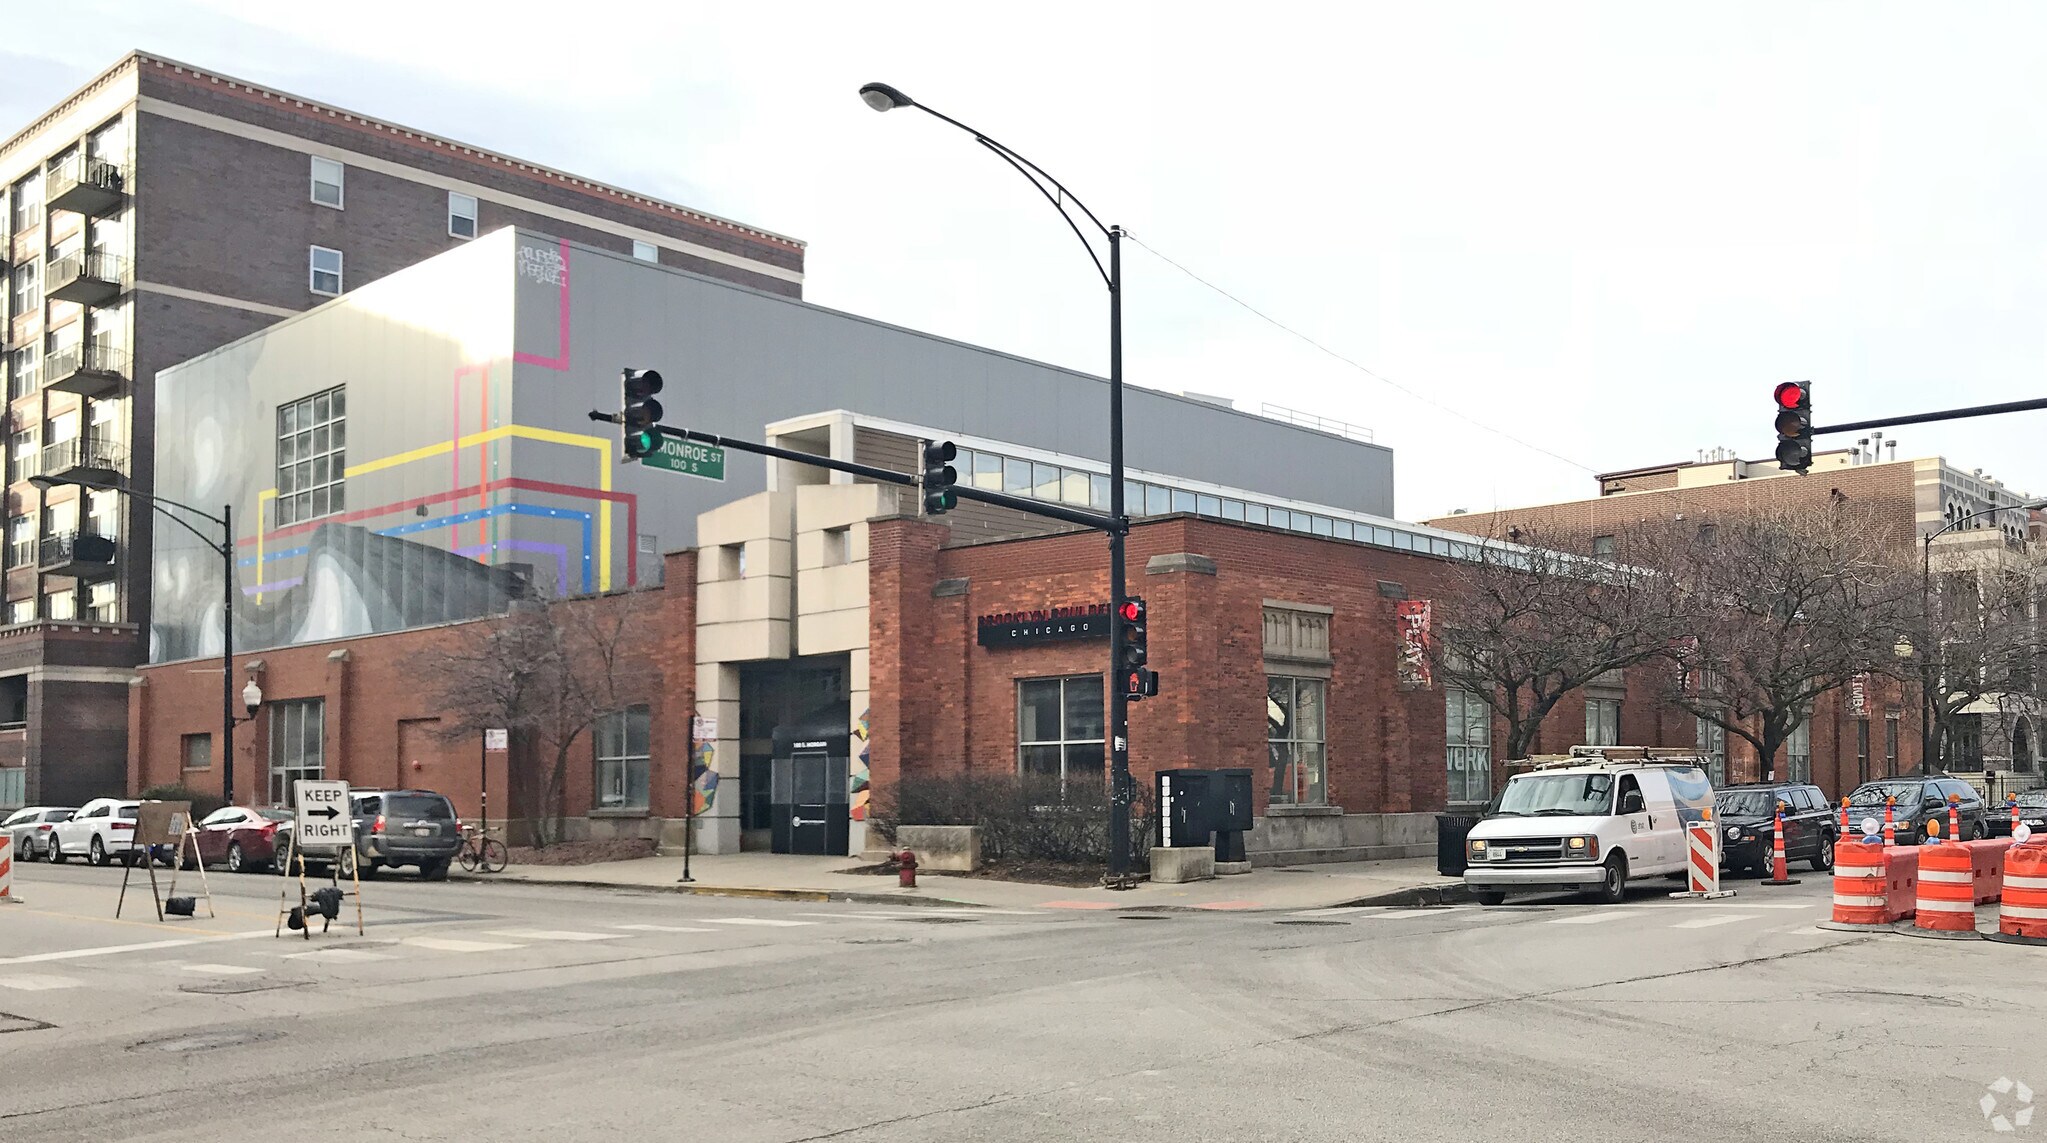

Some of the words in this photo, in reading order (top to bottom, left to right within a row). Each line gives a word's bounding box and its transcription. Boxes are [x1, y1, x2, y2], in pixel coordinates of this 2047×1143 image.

[658, 441, 708, 463] MONROE
[710, 452, 722, 463] ST
[670, 458, 687, 471] 100
[691, 462, 698, 473] S
[1051, 602, 1111, 620] BOULDE
[1011, 623, 1089, 638] CHICAGO
[304, 790, 342, 802] KEEP
[304, 824, 348, 837] RIGHT
